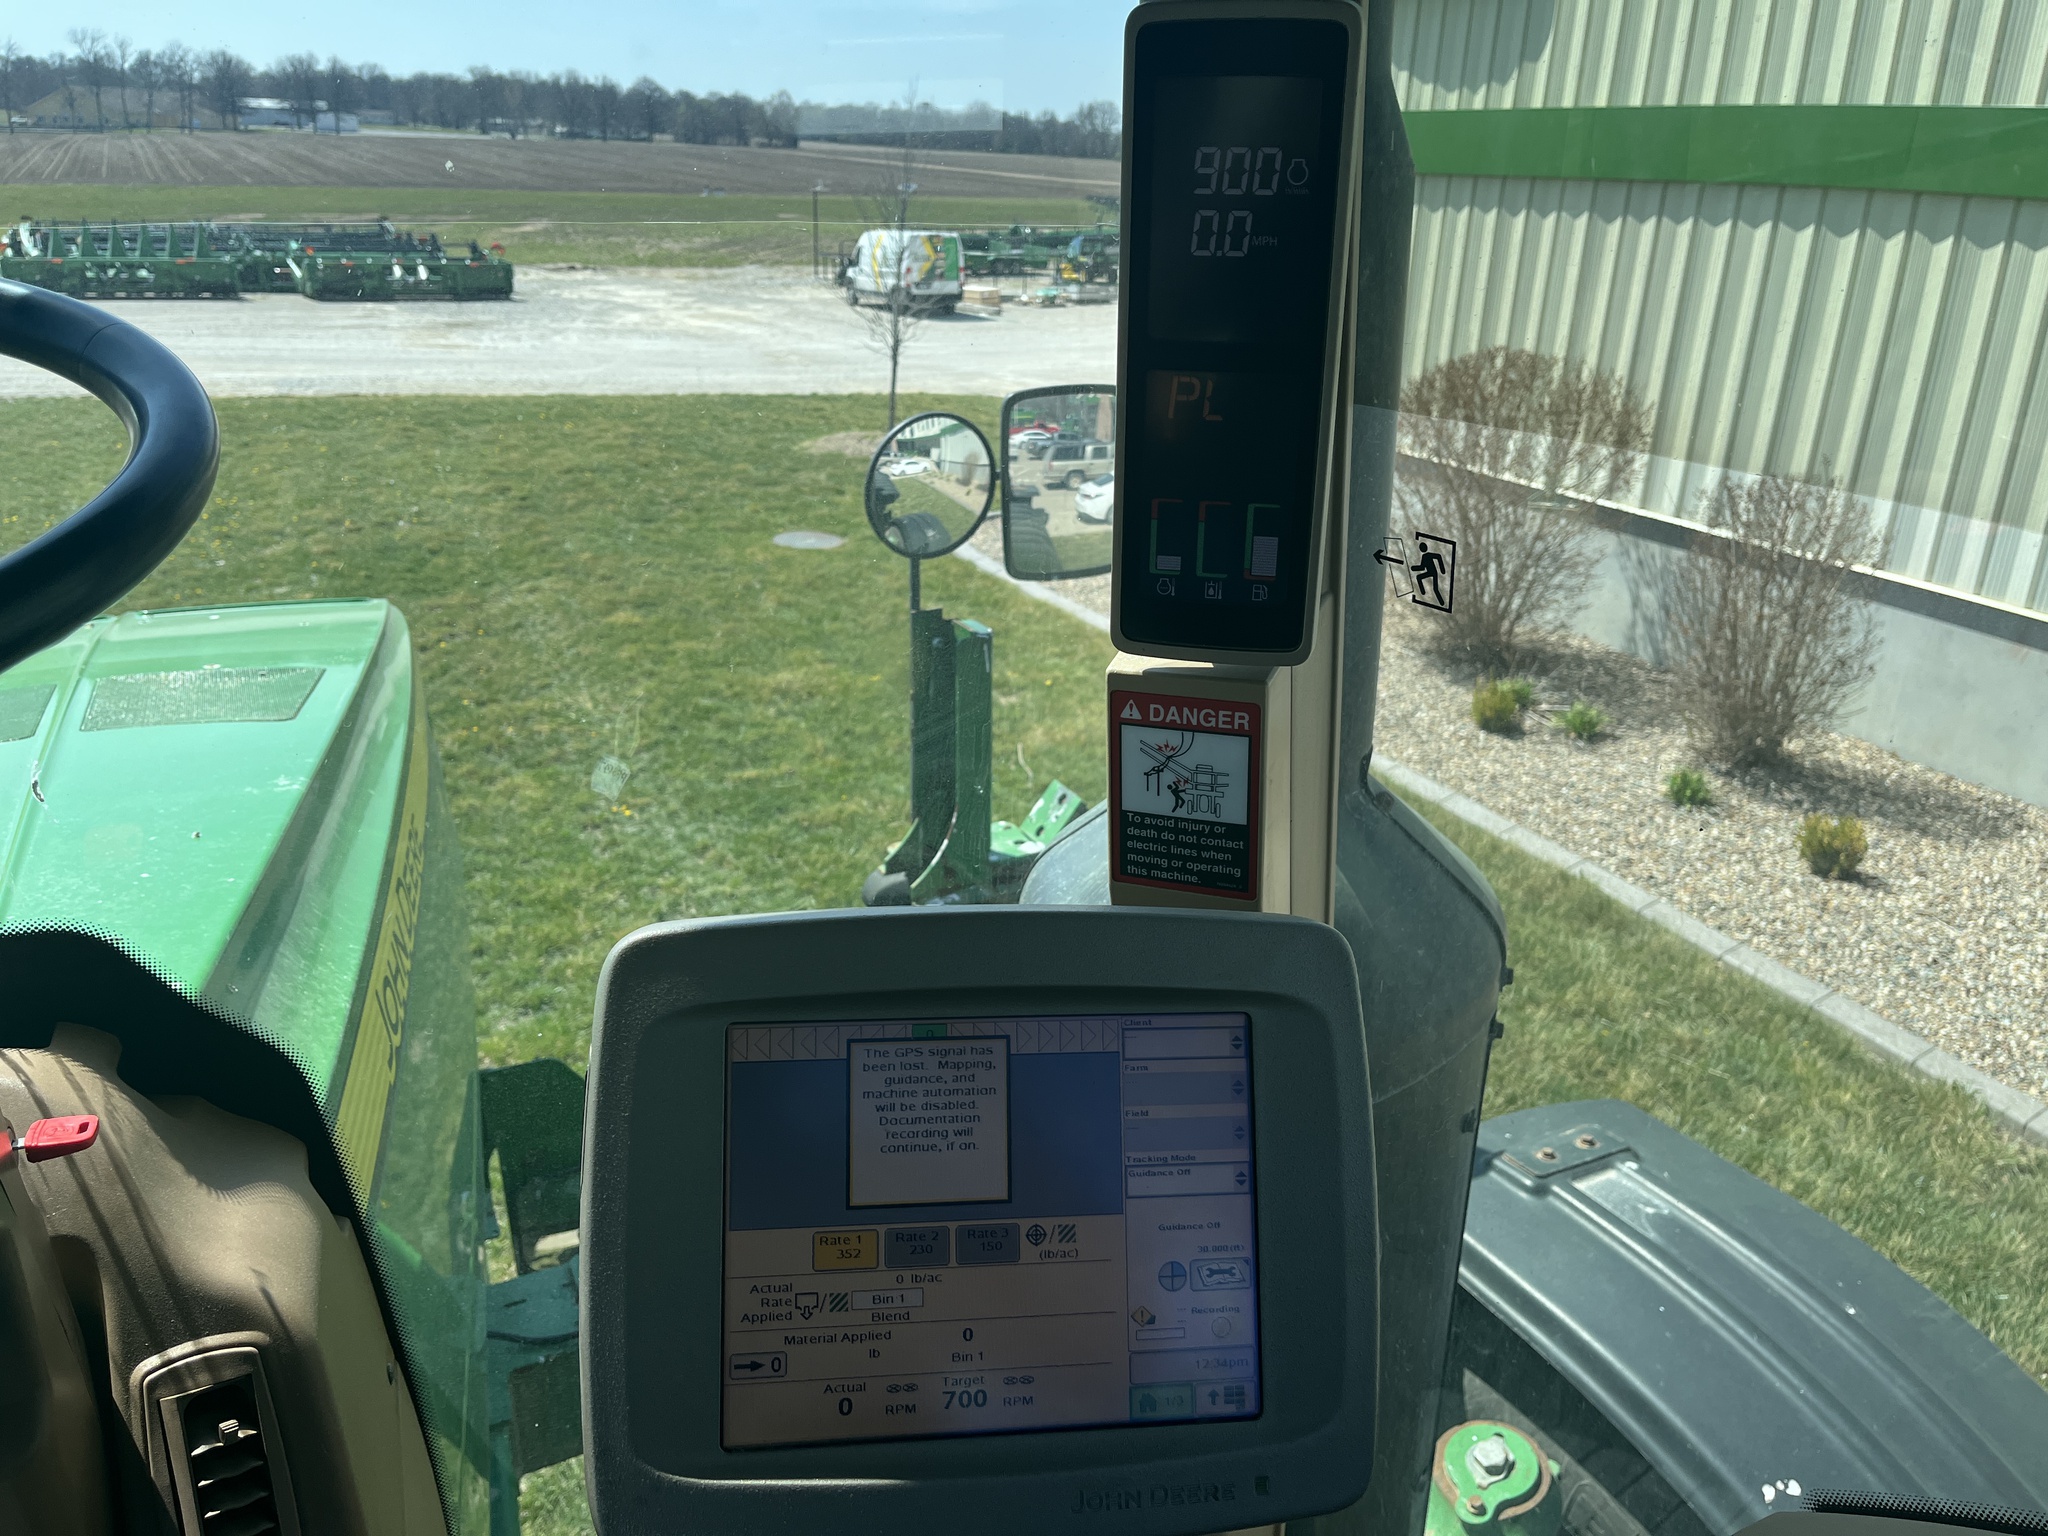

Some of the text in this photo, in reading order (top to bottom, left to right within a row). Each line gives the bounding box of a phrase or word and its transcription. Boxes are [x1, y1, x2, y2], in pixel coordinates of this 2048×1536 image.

[1193, 146, 1282, 195] 900
[1190, 209, 1278, 257] 0.0 MPH
[1167, 375, 1223, 421] PL
[1149, 703, 1250, 731] DANGER
[1127, 812, 1227, 834] To avoid injury or
[1127, 827, 1244, 850] death do not contact
[1127, 840, 1232, 861] electric lines when
[1127, 852, 1241, 877] moving or operating
[1127, 865, 1202, 884] this machine.
[375, 813, 422, 1072] JOHN DEERE
[1123, 1019, 1152, 1027] Client
[864, 1045, 993, 1058] The GPS signal has
[862, 1060, 996, 1072] been lost. Mapping,
[1124, 1064, 1149, 1072] Farm
[884, 1073, 976, 1087] guidance, and
[862, 1085, 997, 1099] machine automation
[875, 1099, 979, 1113] will be disabled.
[879, 1113, 981, 1126] Documentation
[1125, 1109, 1149, 1117] Field
[886, 1126, 973, 1140] recording will
[880, 1140, 980, 1154] continue, if on.
[1126, 1153, 1196, 1163] Tracking Mode
[1128, 1168, 1191, 1178] Guidance Off
[1158, 1221, 1221, 1231] Guidance Off
[895, 1231, 939, 1243] Rate 2
[967, 1227, 1009, 1239] Rate 3
[819, 1235, 862, 1246] Rate 1
[980, 1241, 1003, 1252] 150
[836, 1249, 861, 1259] 352
[909, 1244, 933, 1255] 230
[1039, 1248, 1079, 1261] (lb/ac)
[896, 1272, 943, 1284] 0 lb/ac
[750, 1282, 793, 1294] Actual
[761, 1297, 793, 1308] Rate
[872, 1294, 904, 1305] Bin 1
[1191, 1305, 1240, 1314] Recording
[740, 1310, 793, 1324] Applied
[871, 1311, 910, 1322] Blend
[784, 1330, 892, 1345] Material Applied
[962, 1327, 974, 1342] 0
[868, 1348, 881, 1358] lb
[952, 1351, 984, 1362] Bin 1
[771, 1356, 782, 1372] 0
[823, 1382, 867, 1394] Actual
[942, 1375, 985, 1388] Target
[942, 1389, 988, 1410] 700
[1003, 1396, 1034, 1407] RPM
[838, 1397, 853, 1416] 0
[885, 1404, 917, 1415] RPM
[1071, 1482, 1236, 1514] JOHN DEERE
